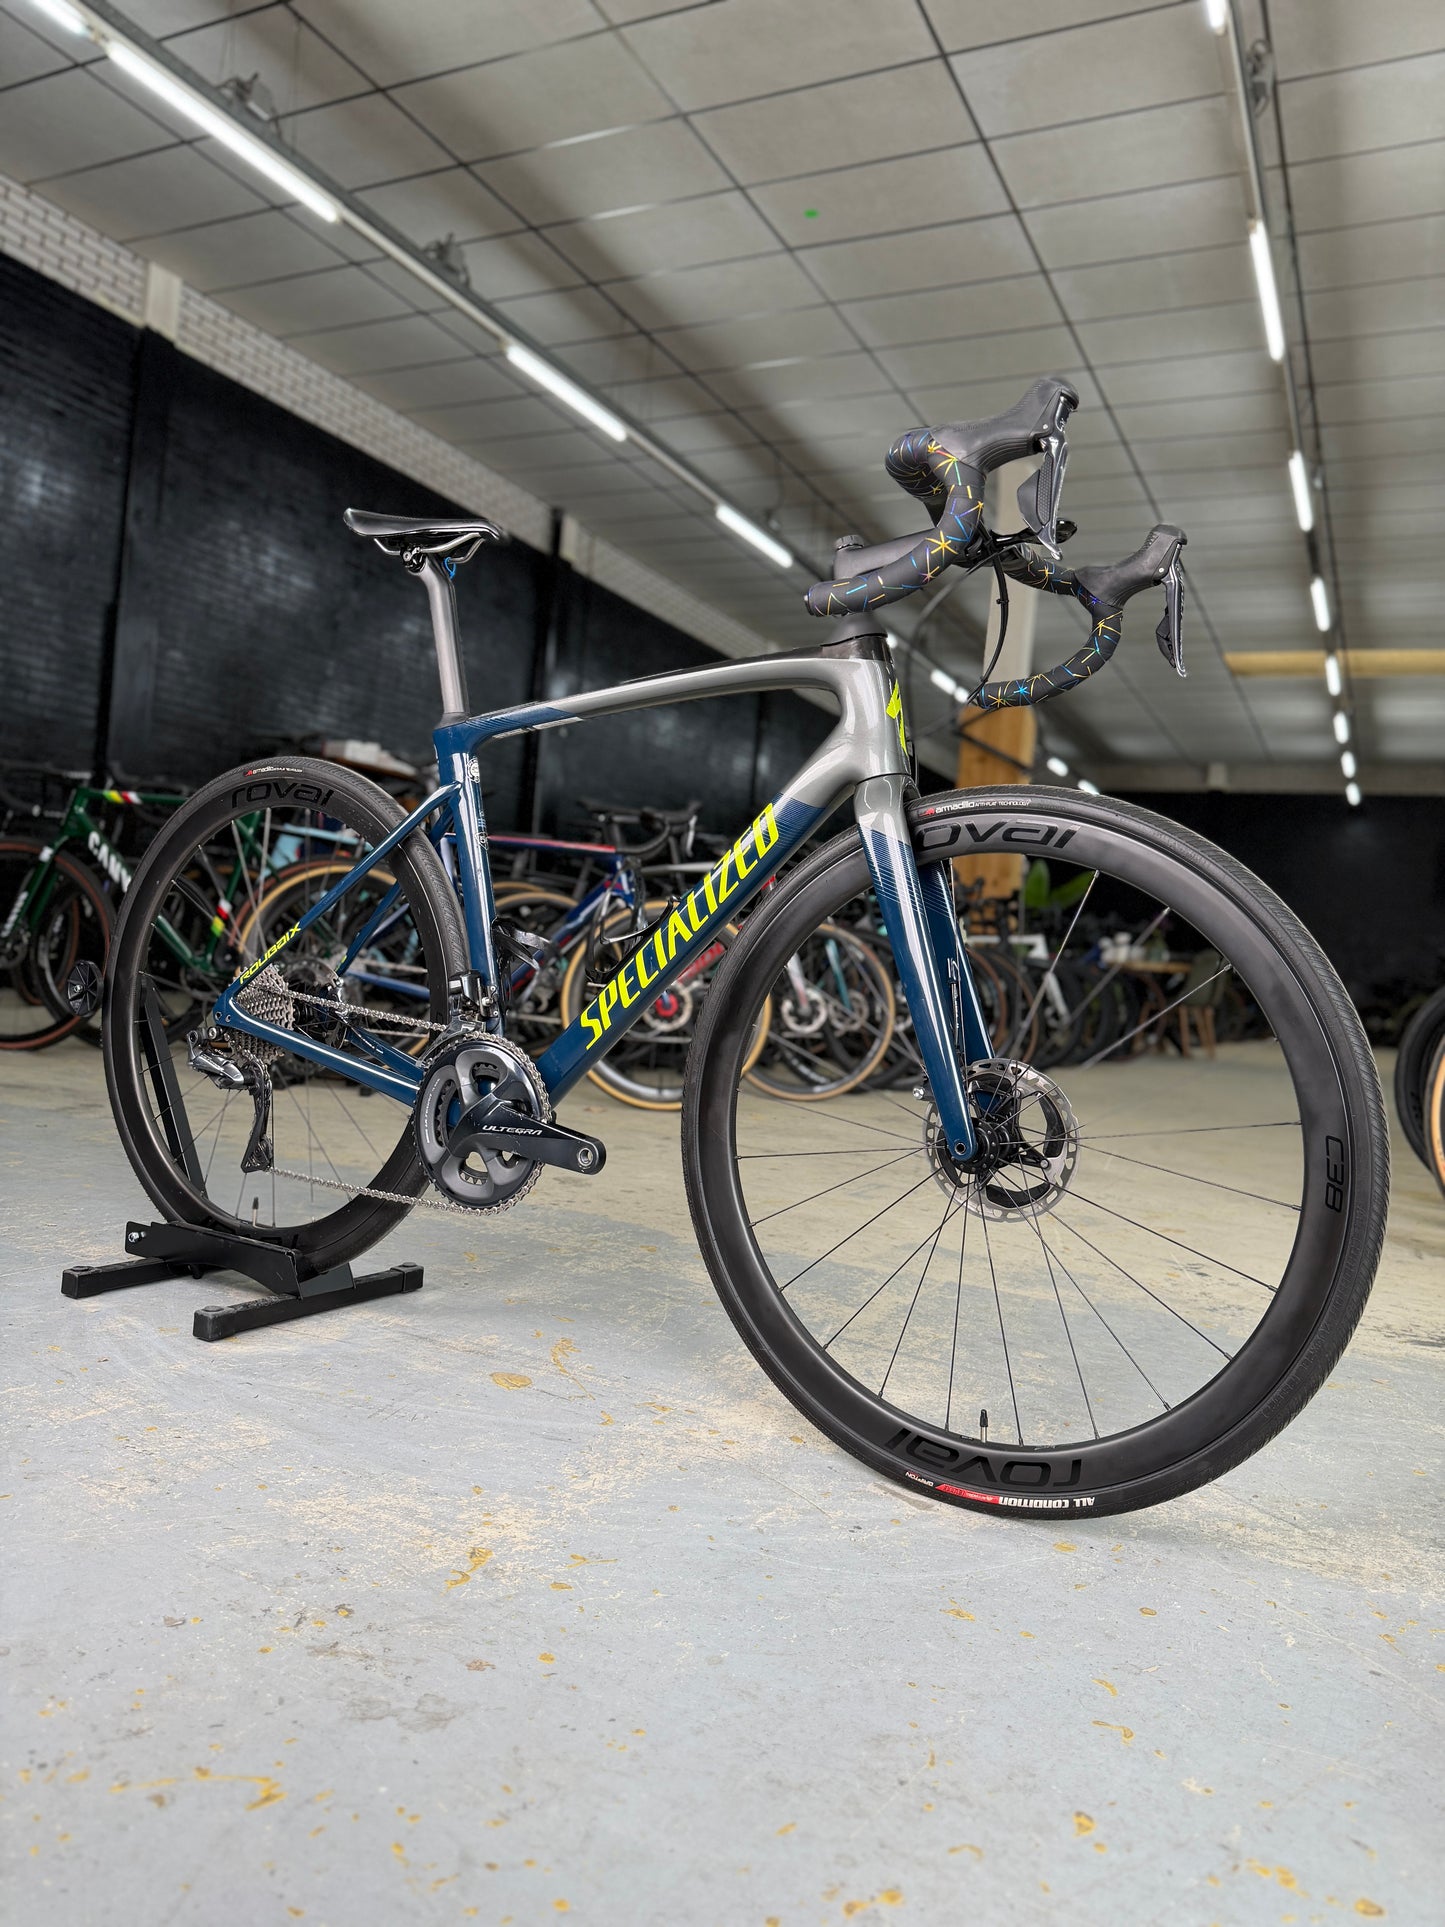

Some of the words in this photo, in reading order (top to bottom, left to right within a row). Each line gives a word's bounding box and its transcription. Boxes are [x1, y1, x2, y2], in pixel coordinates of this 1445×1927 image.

[936, 801, 975, 813] armadillo
[914, 821, 1081, 849] oval
[581, 803, 789, 1050] SPECIALIZED
[482, 1124, 543, 1136] ULTEGRA
[1325, 1135, 1345, 1213] C38
[1073, 1497, 1095, 1508] ALL
